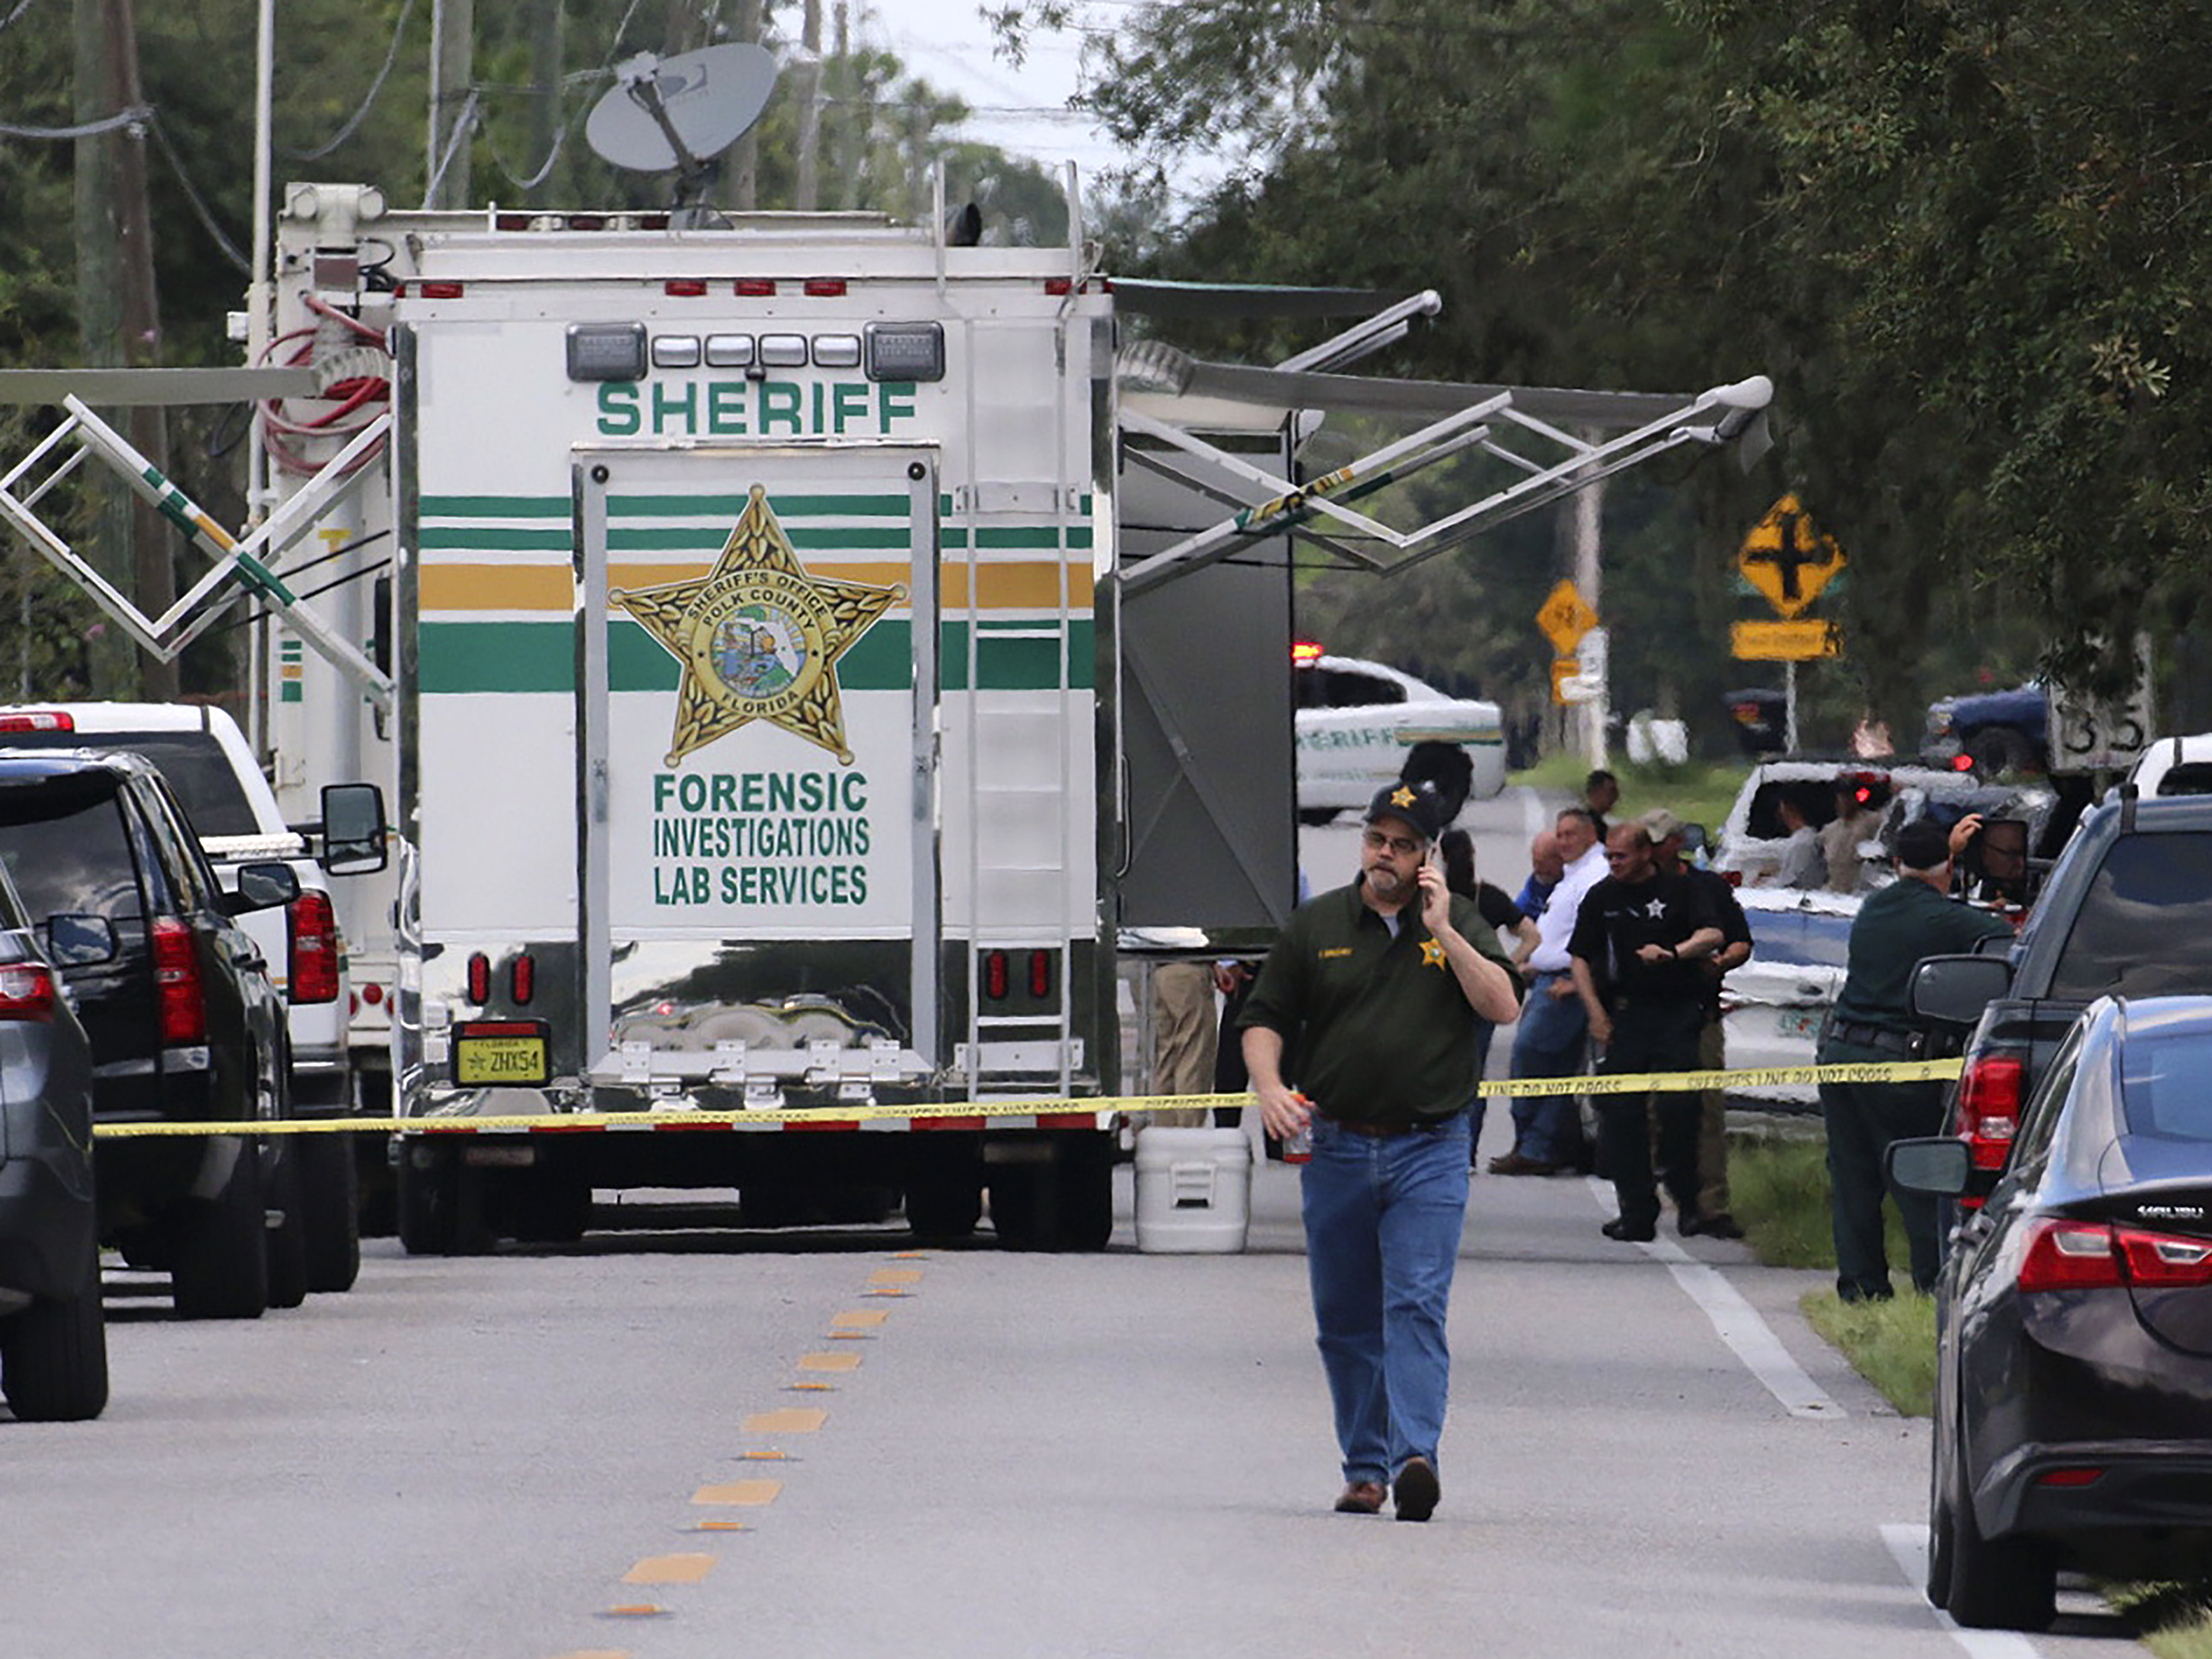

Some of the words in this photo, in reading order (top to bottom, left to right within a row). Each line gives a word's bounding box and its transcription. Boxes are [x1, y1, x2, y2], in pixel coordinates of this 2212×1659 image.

[597, 381, 917, 436] SHERIFF
[688, 572, 769, 619] SHERIFF'S
[777, 575, 828, 618] OFFICE
[703, 593, 744, 627] POLK
[750, 589, 816, 629] COUNTY
[722, 690, 799, 713] FLORIDA
[655, 772, 868, 812] FORENSIC
[655, 817, 870, 857] INVESTIGATIONS
[655, 866, 710, 905] LAB
[721, 865, 868, 905] SERVICES
